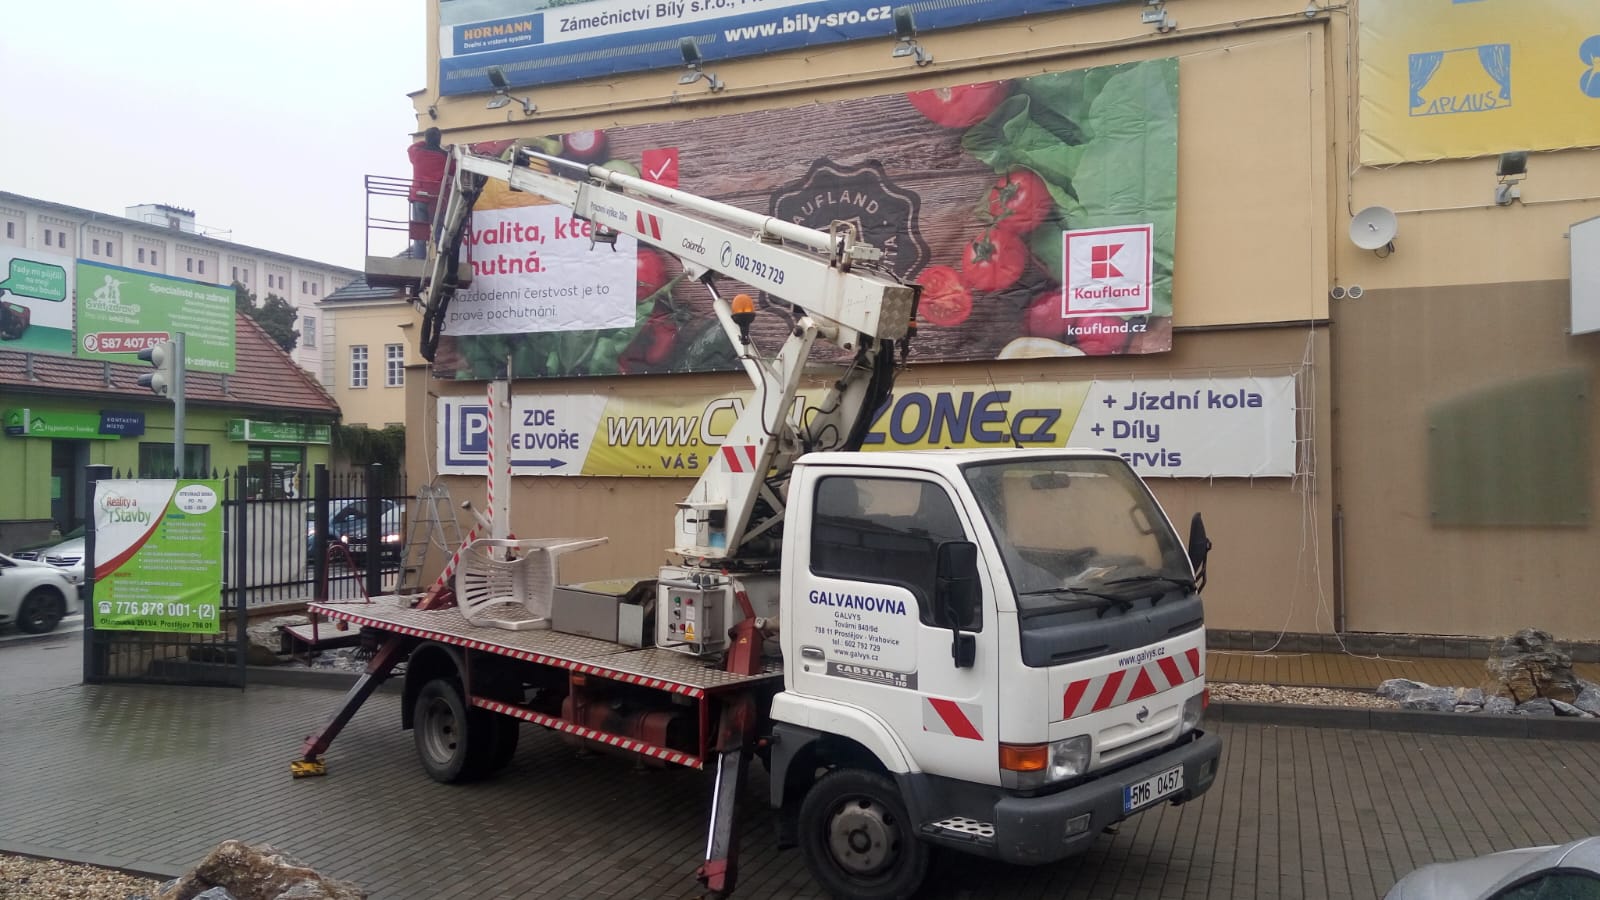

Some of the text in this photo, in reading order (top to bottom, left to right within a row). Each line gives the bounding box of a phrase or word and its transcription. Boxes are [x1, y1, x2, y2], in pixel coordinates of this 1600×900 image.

[560, 5, 650, 32] Zámečnictví
[656, 1, 684, 19] Bílý
[724, 6, 891, 42] www.bily-sro.cz
[1427, 91, 1497, 114] APLAUS
[792, 190, 879, 225] AUFLAND
[735, 254, 784, 285] 602 792 729
[452, 285, 610, 303] Každodenní čerstvost je to
[1075, 285, 1140, 299] Kaufland
[451, 308, 483, 323] pravé
[1067, 322, 1147, 335] kaufland.cz
[101, 338, 121, 349] 587
[124, 337, 145, 348] 407
[1123, 390, 1200, 410] Jízdní
[1208, 389, 1262, 409] kola
[523, 409, 555, 426] ZDE
[525, 429, 579, 450] DVOŘE
[1113, 420, 1160, 442] Díly
[660, 453, 699, 470] VÁŠ
[107, 496, 137, 508] Reality a
[115, 507, 151, 526] Stavby
[116, 601, 138, 615] 776
[141, 602, 164, 616] 878
[809, 590, 906, 615] GALVANOVNA
[834, 611, 861, 621] GALVYS
[834, 620, 857, 630] Tovární
[834, 629, 863, 641] Prostějov
[868, 634, 899, 646] Vrahovice
[844, 640, 856, 648] 602
[869, 643, 881, 652] 729
[834, 648, 878, 661] www.galvys.cz
[1118, 646, 1165, 667] www.galvys.cz
[836, 664, 907, 682] CABSTAR.E
[1133, 769, 1179, 805] 5M6 0457
